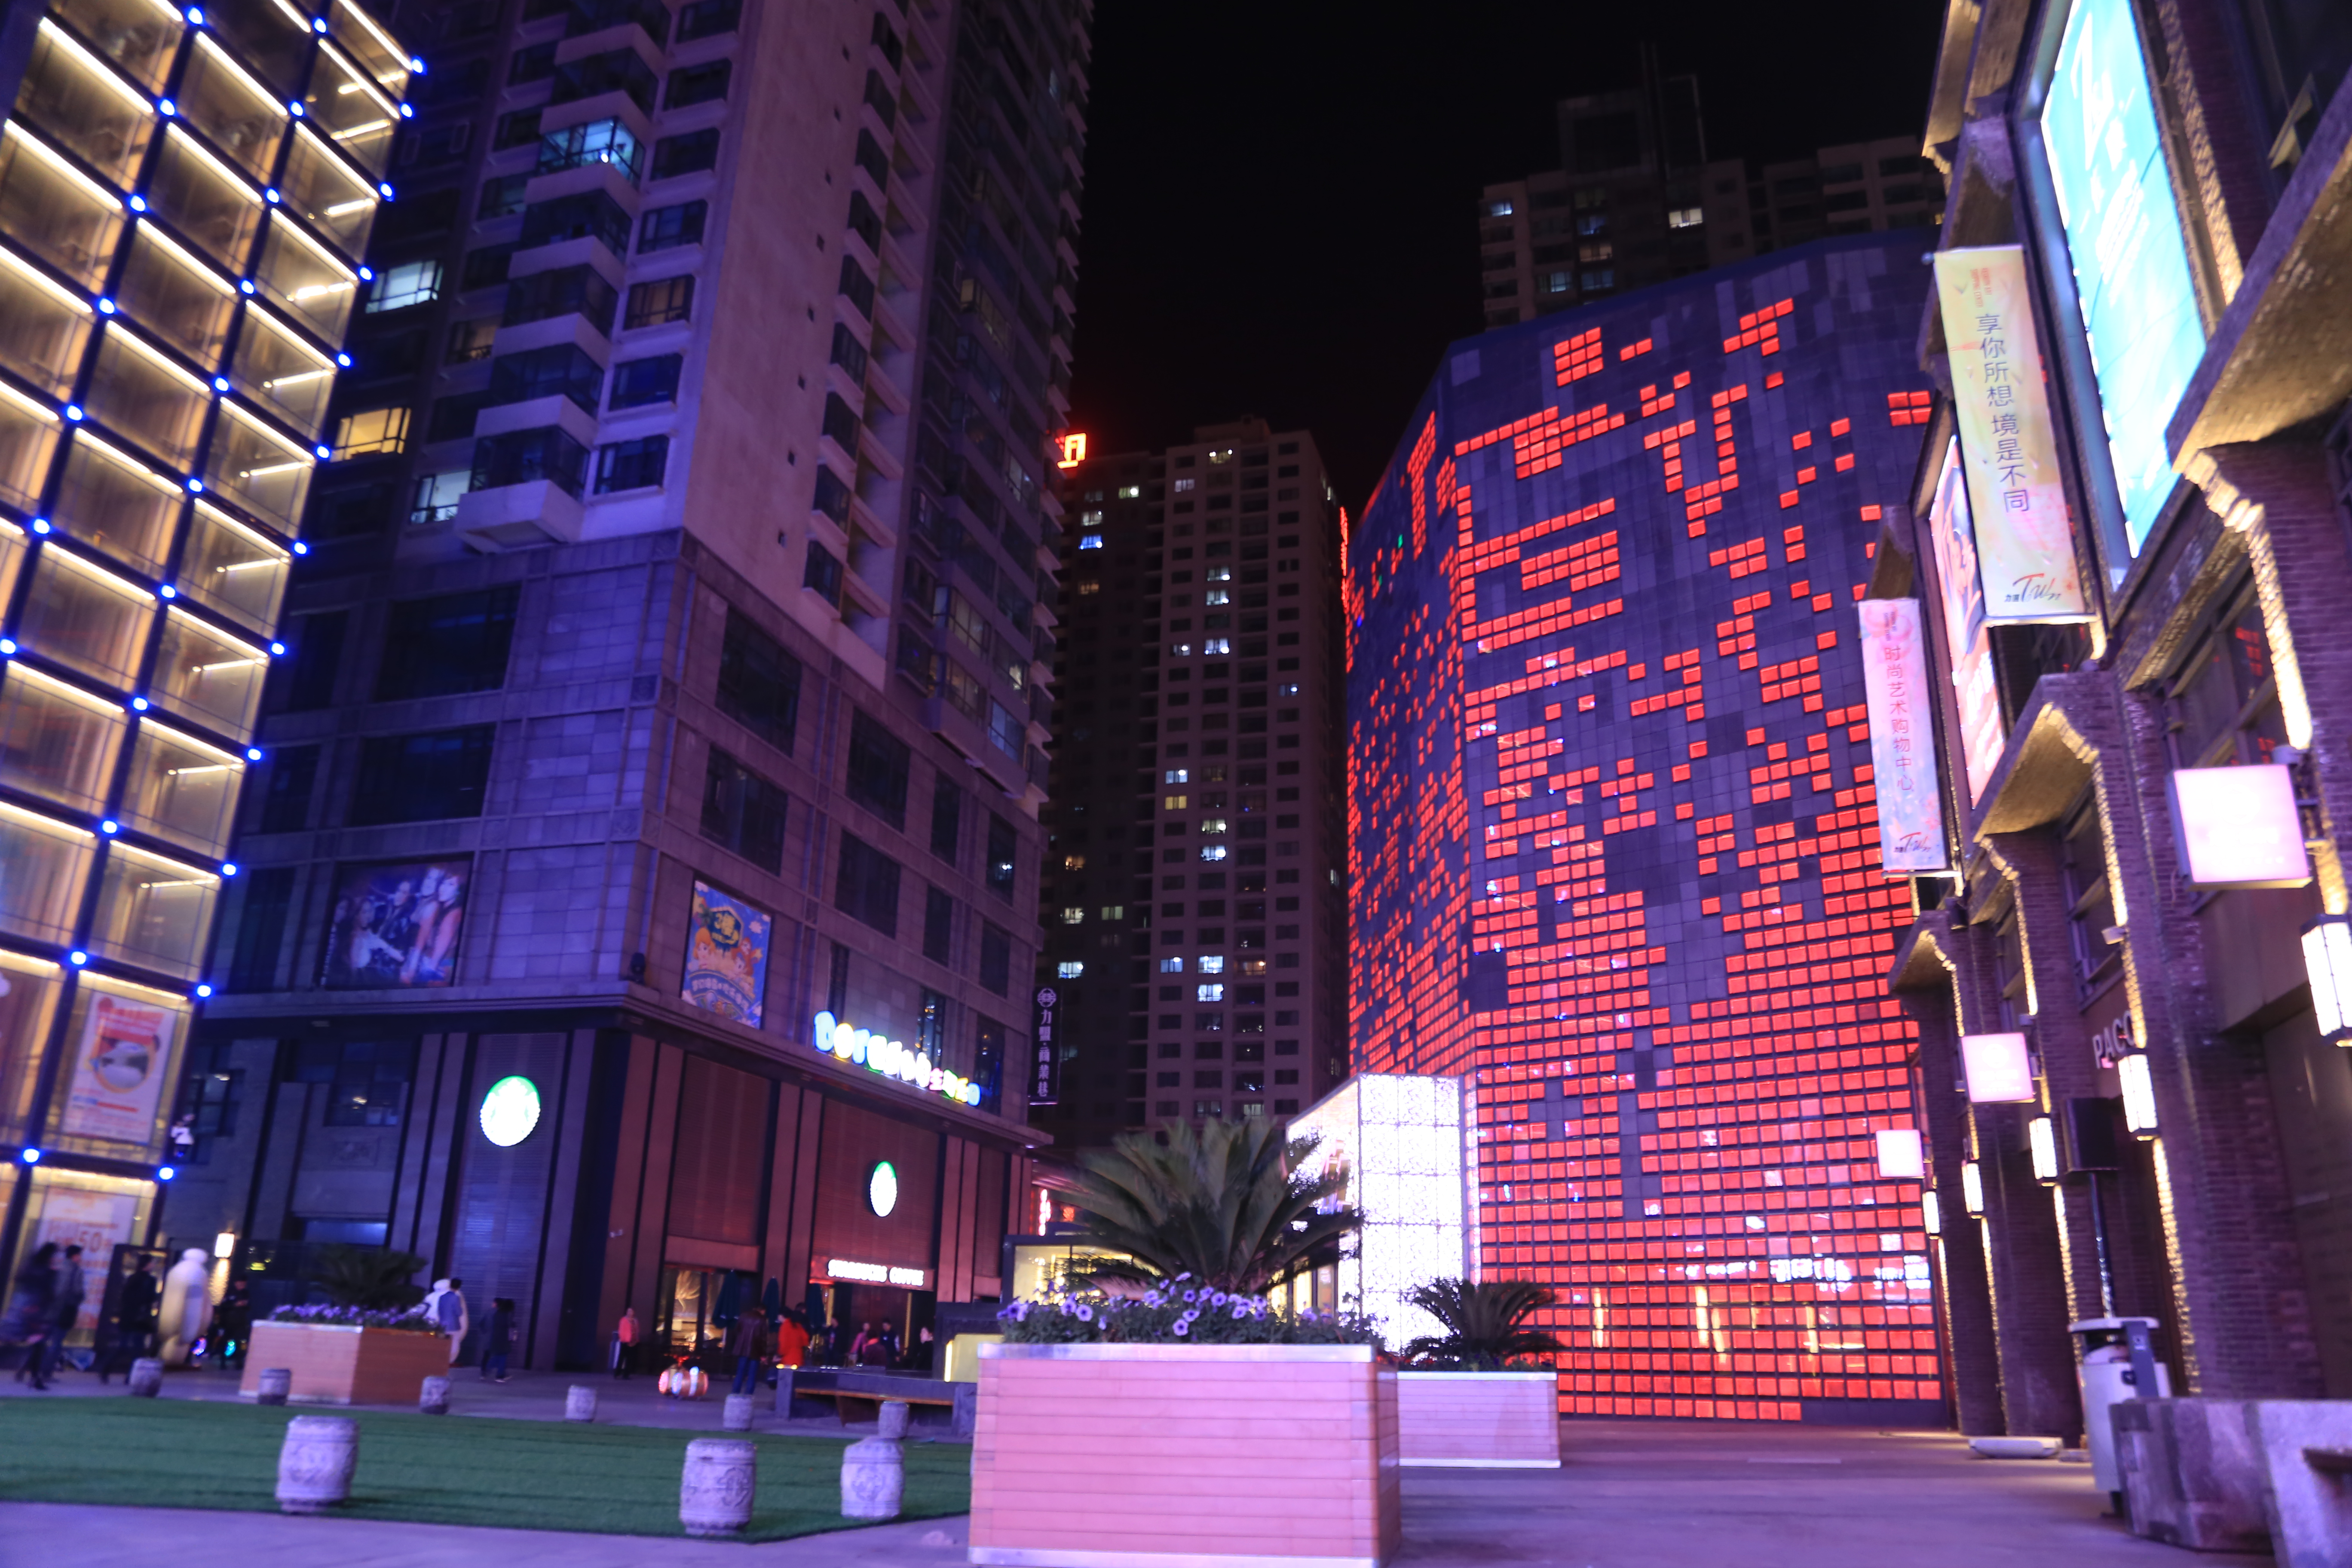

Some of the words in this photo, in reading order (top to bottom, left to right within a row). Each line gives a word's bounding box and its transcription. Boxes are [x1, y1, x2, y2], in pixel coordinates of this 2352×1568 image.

[1975, 313, 2014, 407] 享你所想
[1991, 413, 2030, 512] 境是不同
[1884, 646, 1914, 792] 时尚艺术购物中心
